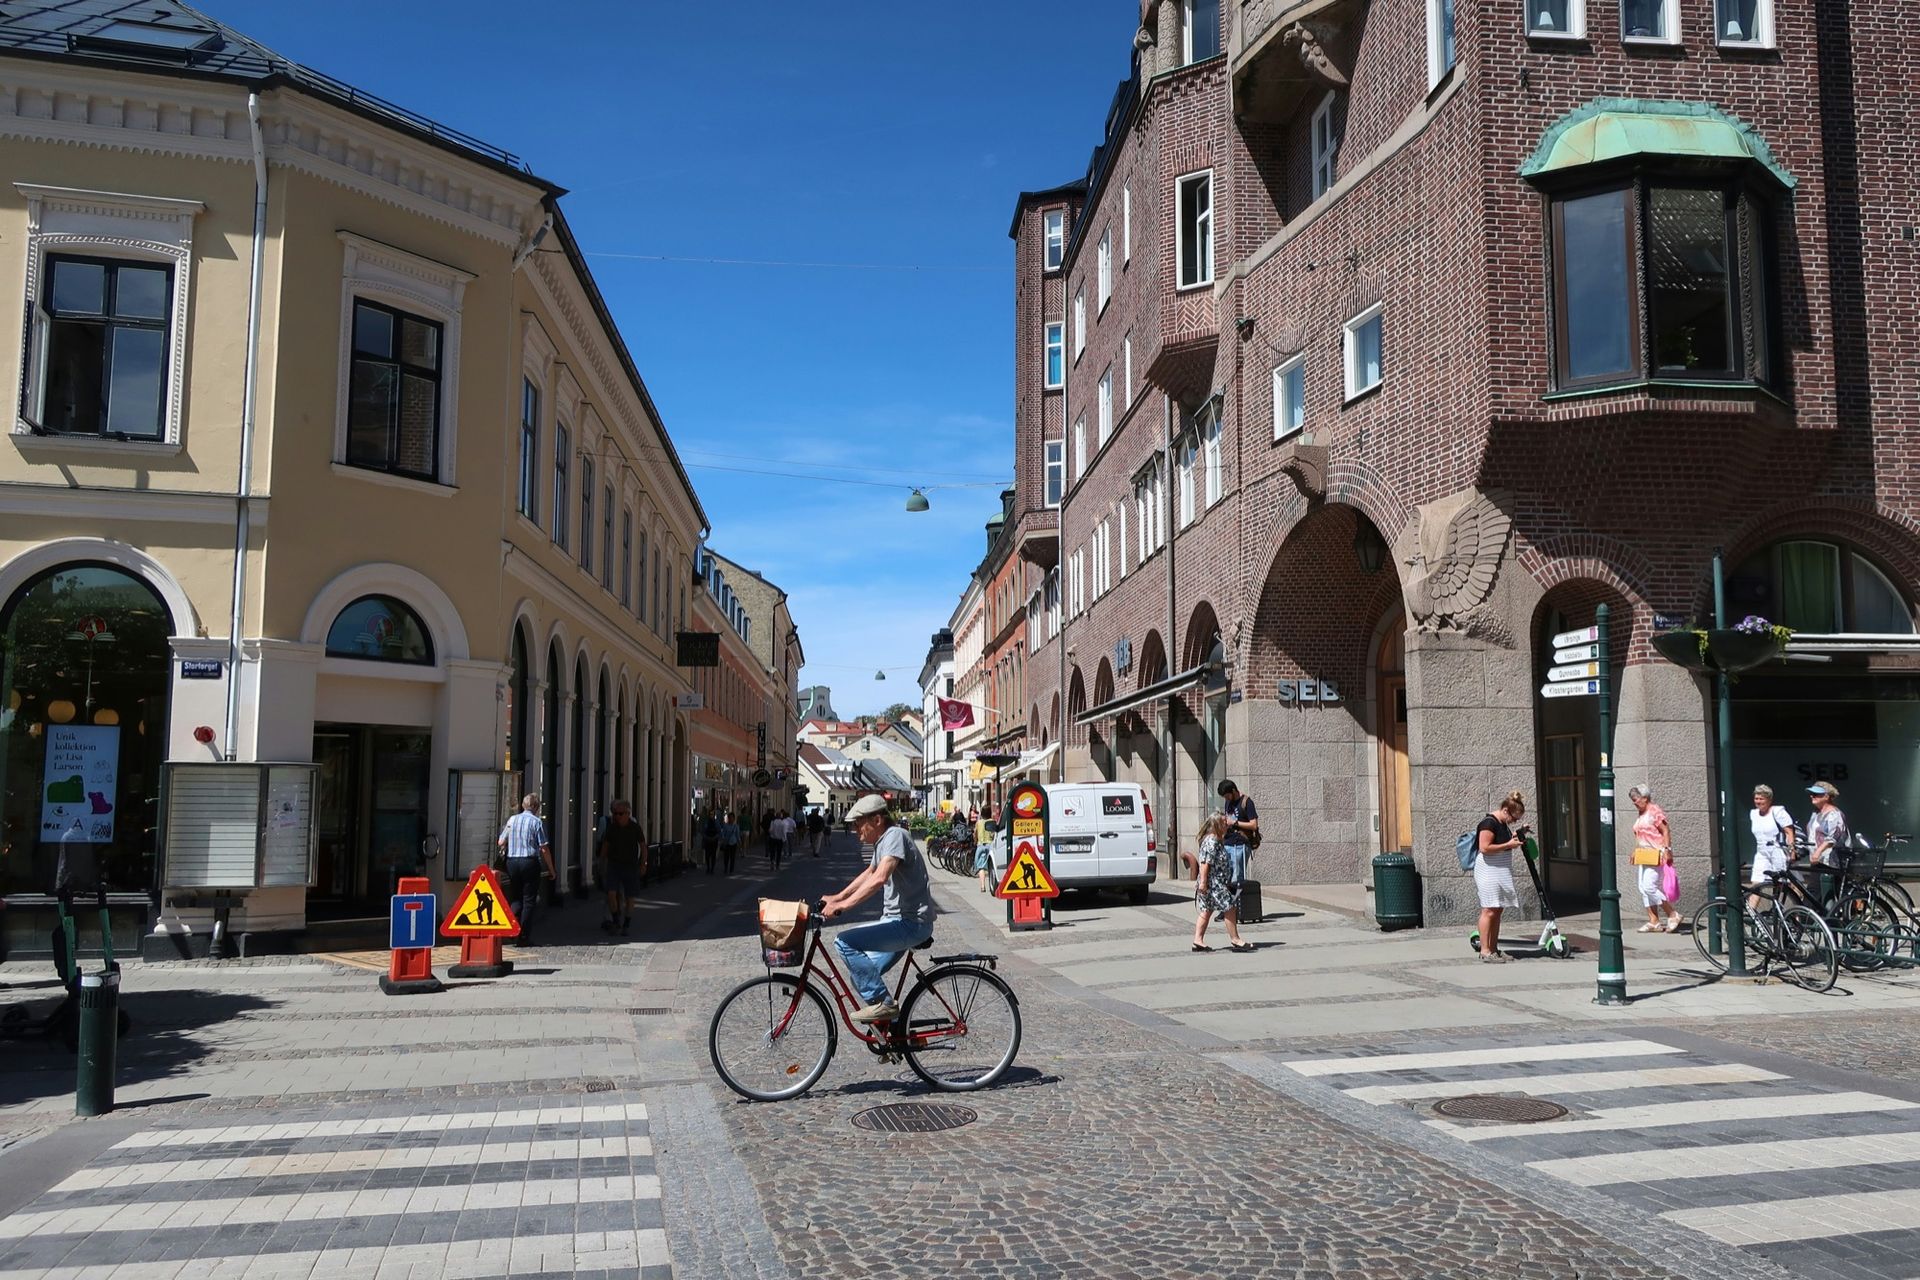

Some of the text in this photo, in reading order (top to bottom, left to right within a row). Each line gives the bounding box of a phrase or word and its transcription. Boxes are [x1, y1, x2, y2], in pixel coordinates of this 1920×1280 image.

[1278, 678, 1340, 702] SEB
[1549, 685, 1583, 695] Klostergården
[56, 732, 76, 741] Unik
[54, 742, 97, 751] kollektion
[66, 753, 83, 761] Lisa
[1797, 763, 1849, 781] SEB
[1105, 804, 1132, 813] LOOMIS
